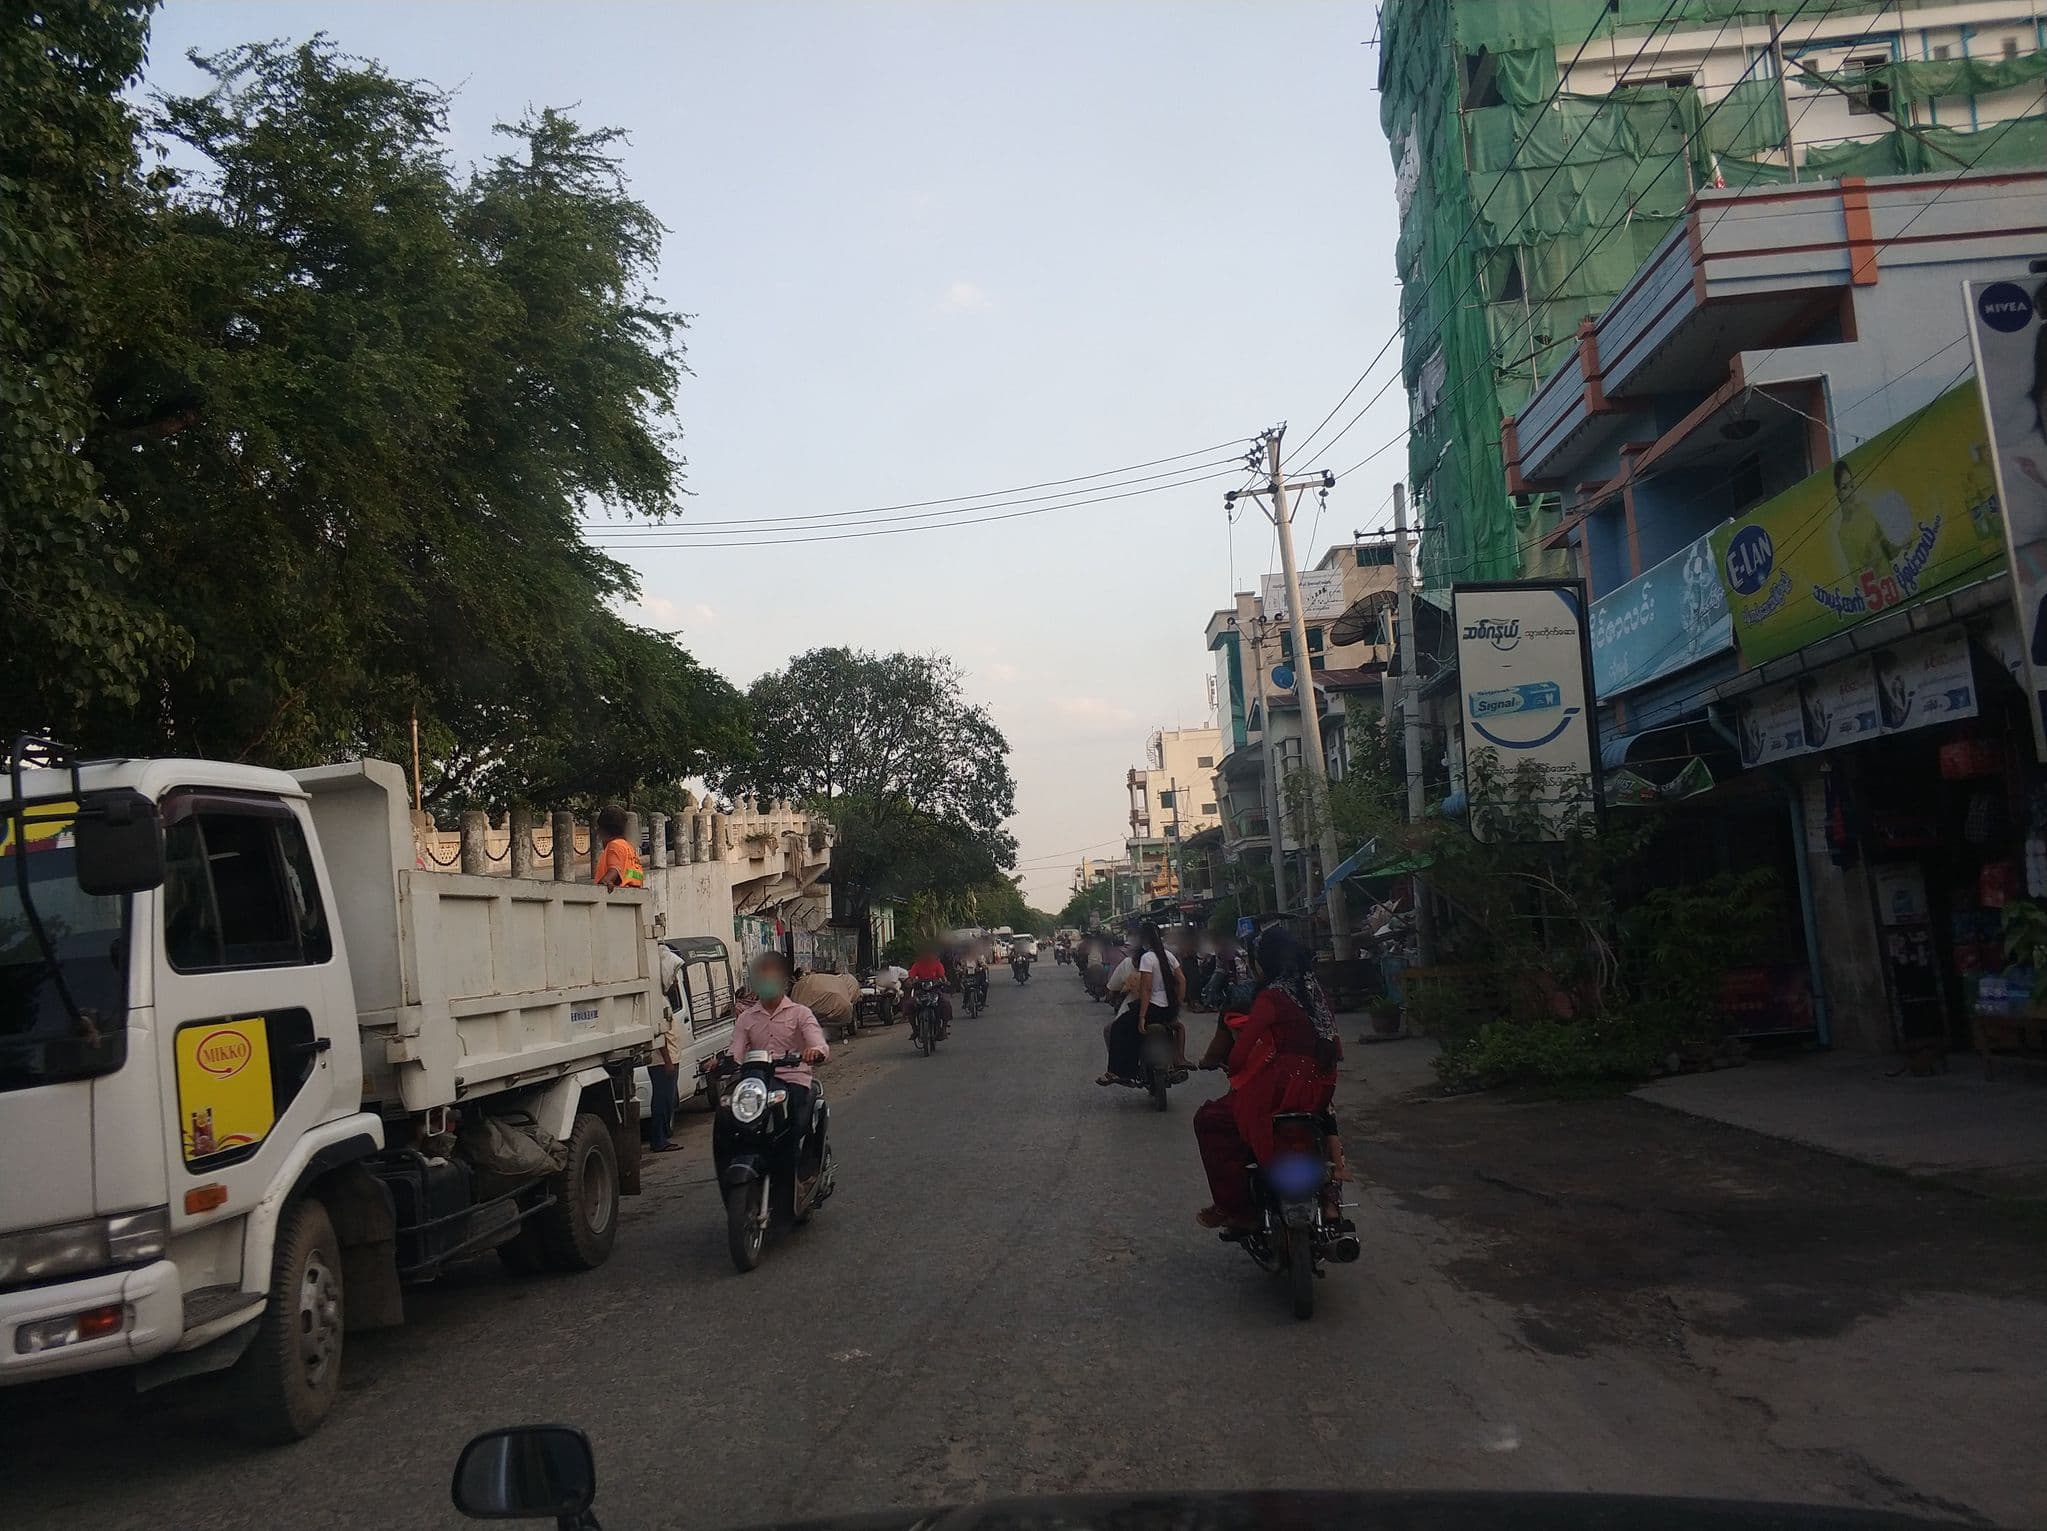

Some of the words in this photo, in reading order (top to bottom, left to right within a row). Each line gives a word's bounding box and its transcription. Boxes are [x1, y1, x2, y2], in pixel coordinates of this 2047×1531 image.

[1984, 302, 2028, 314] NIVEA
[1478, 697, 1516, 713] Signal
[203, 1043, 247, 1063] MIKKO
